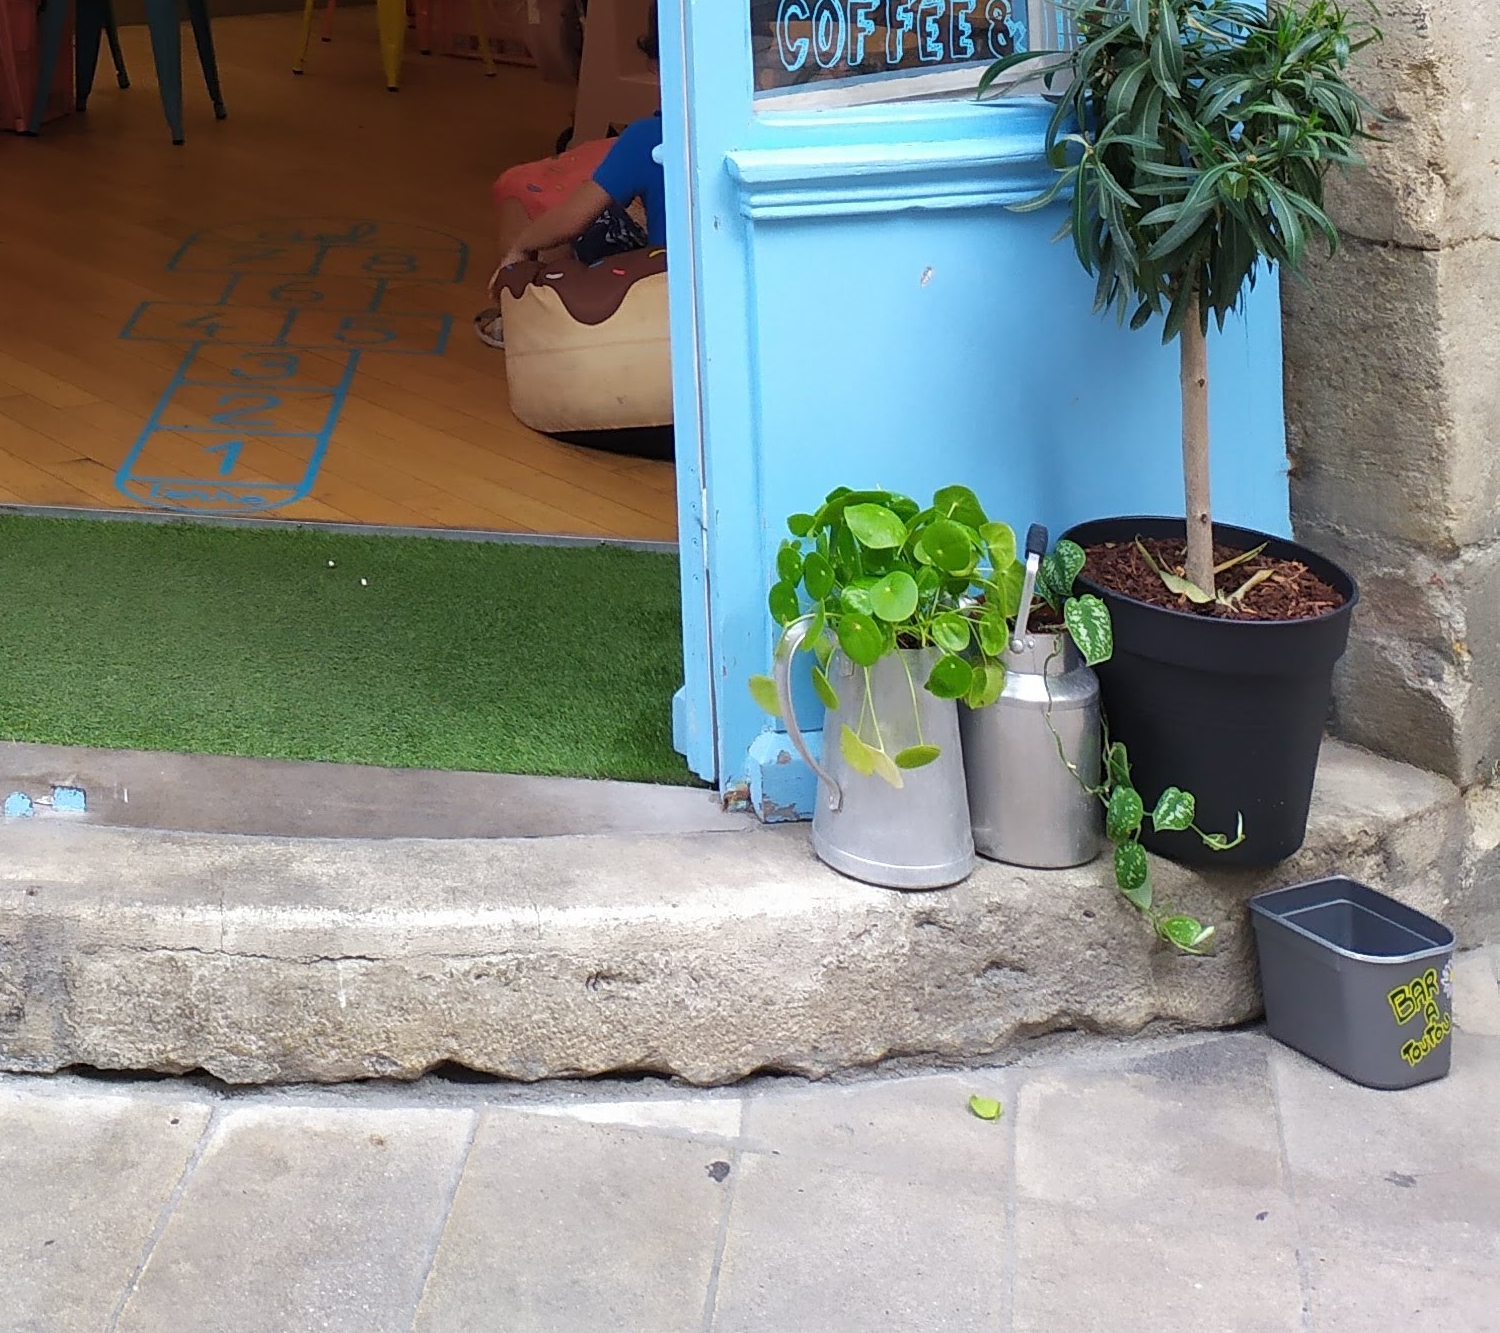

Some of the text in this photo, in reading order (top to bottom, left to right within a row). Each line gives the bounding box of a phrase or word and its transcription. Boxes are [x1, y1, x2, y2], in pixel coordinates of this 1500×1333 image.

[332, 315, 396, 343] 5
[229, 351, 299, 379] 3
[209, 392, 282, 425] 2
[202, 440, 244, 475] 1
[1387, 968, 1439, 1025] BAR
[1400, 1012, 1452, 1067] TOUTOU
